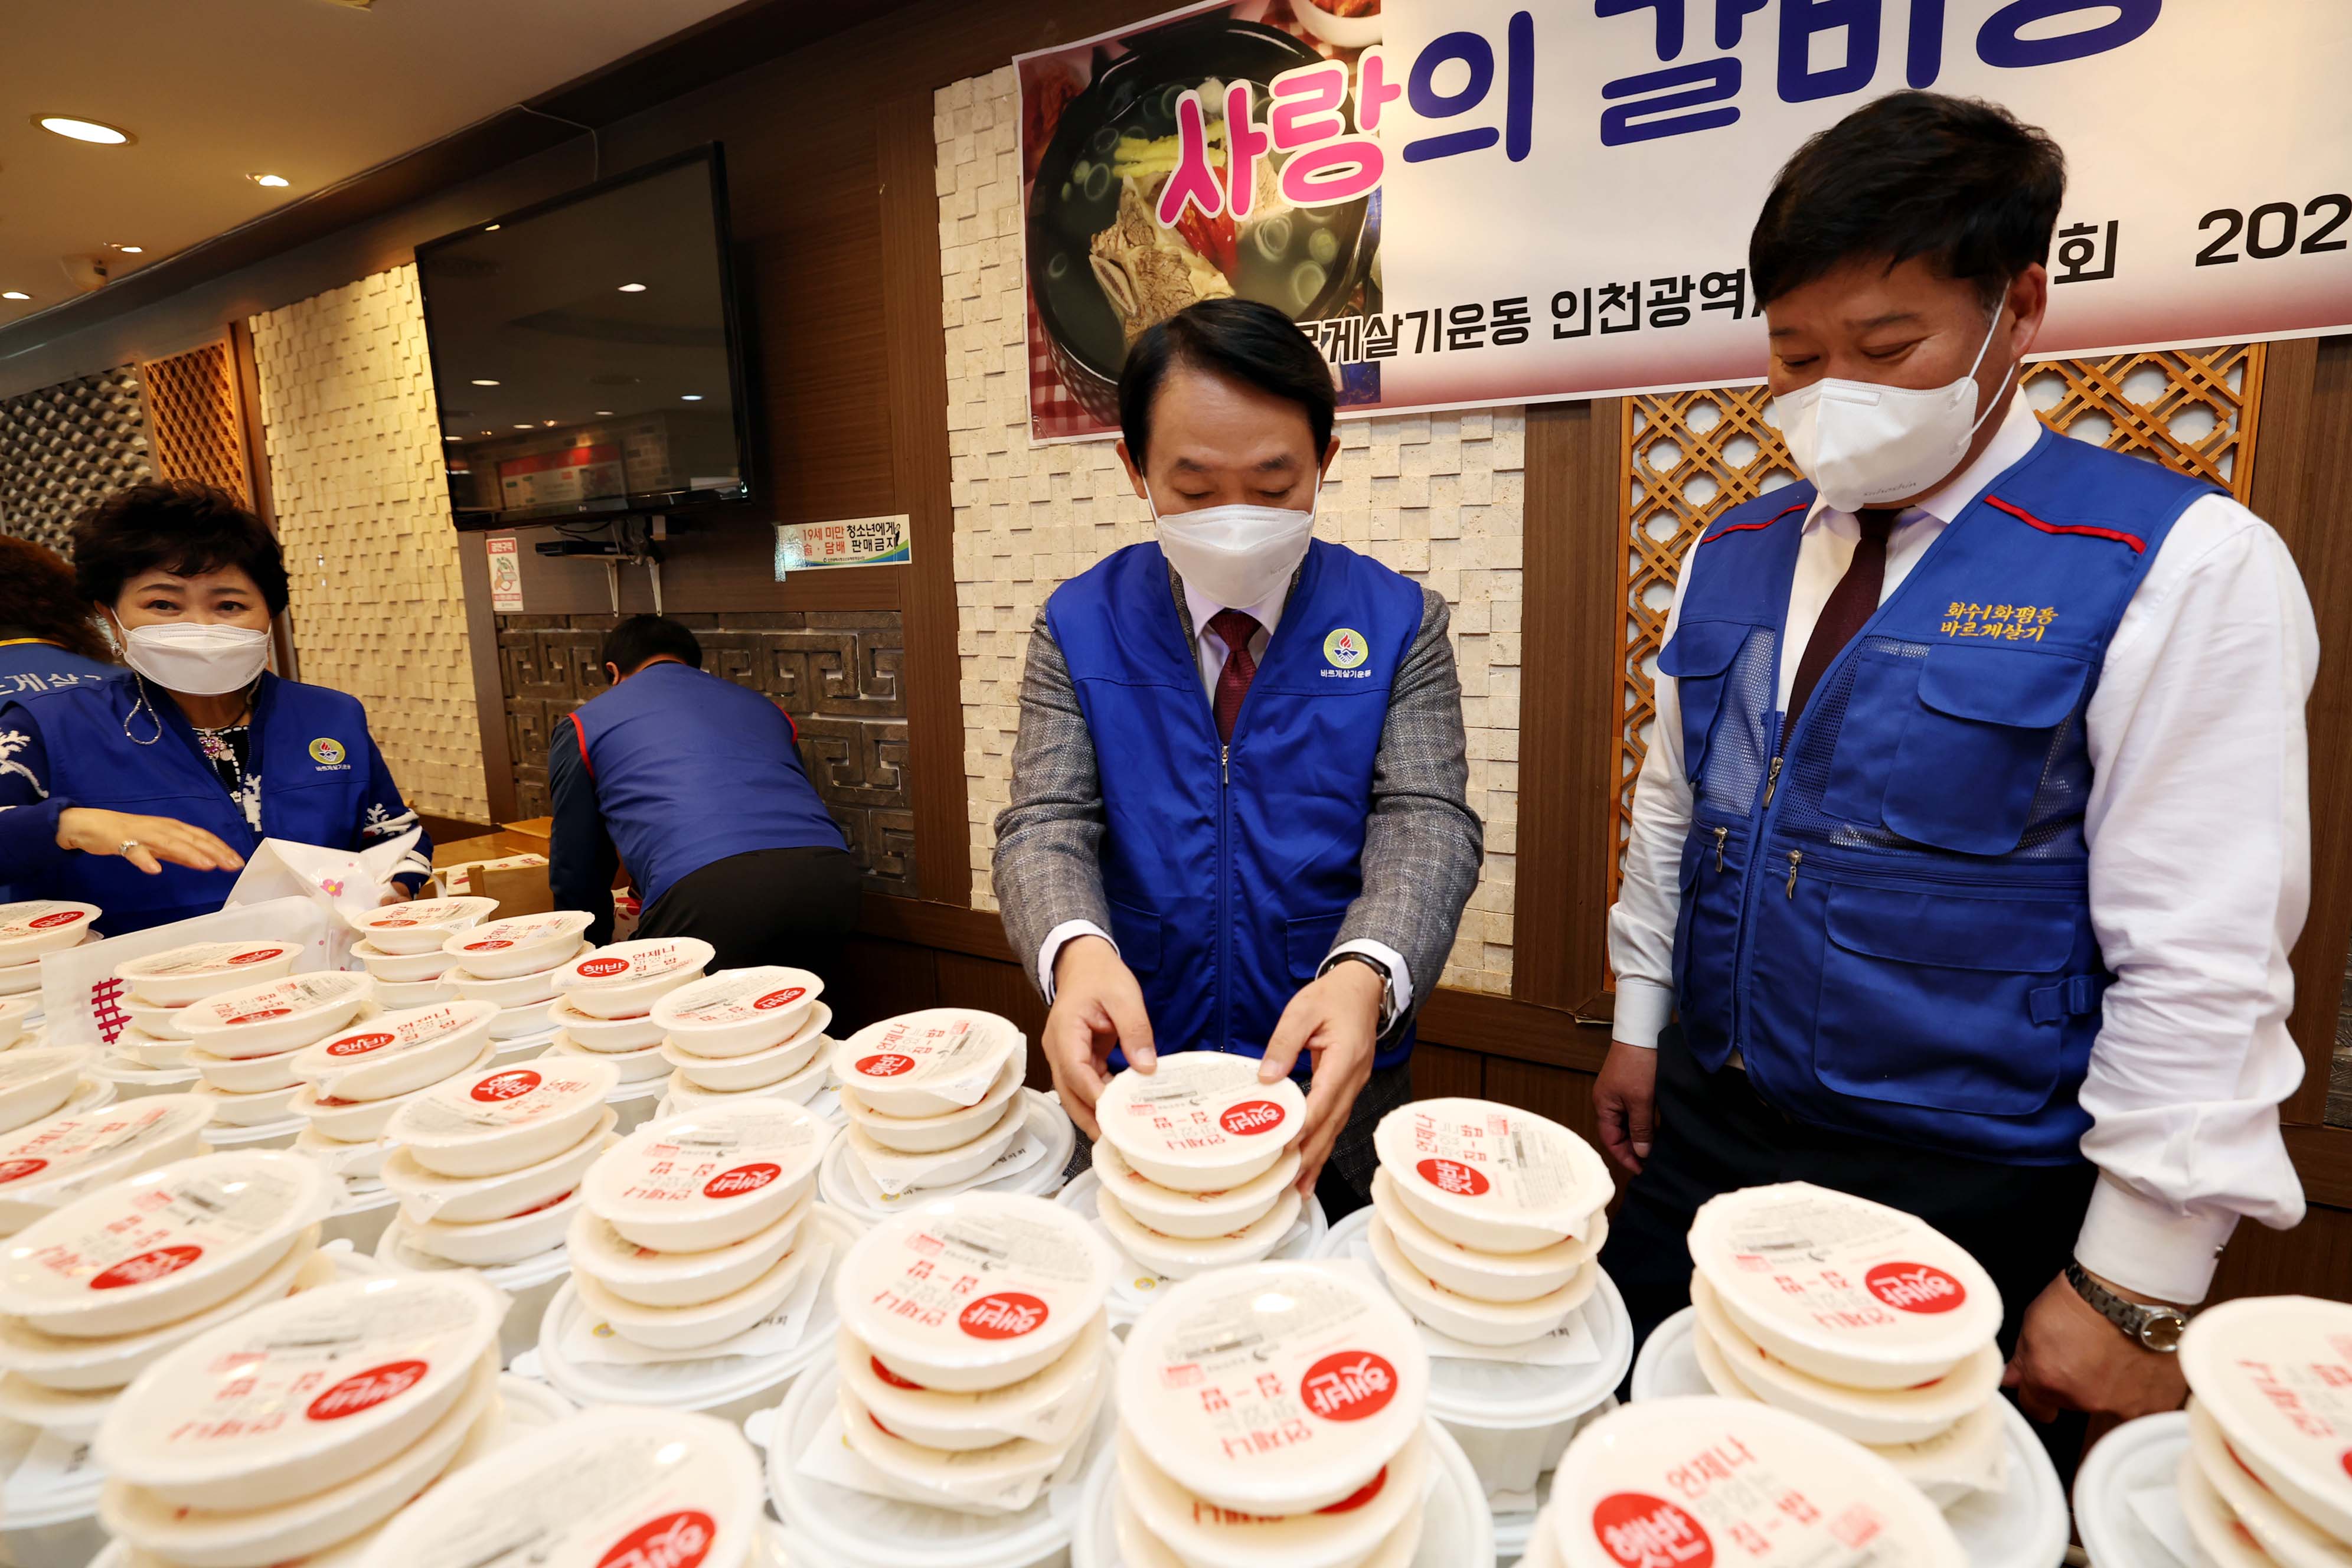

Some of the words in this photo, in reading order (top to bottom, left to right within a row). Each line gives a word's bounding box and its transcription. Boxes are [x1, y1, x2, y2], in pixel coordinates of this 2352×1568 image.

[1158, 11, 1534, 227] 사랑의
[1550, 269, 1764, 339] 인천광역
[803, 527, 822, 541] 19세
[826, 526, 844, 540] 미만
[847, 522, 895, 538] 청소년에게
[825, 541, 845, 554] 담배
[852, 537, 896, 553] 판매금지
[1941, 620, 2045, 642] 바르게살기
[633, 945, 675, 961] 언제나
[583, 961, 626, 975] 햇반
[876, 1023, 910, 1051] 언제나
[865, 1054, 907, 1076] 햇반
[1225, 1103, 1279, 1132] 햇반
[1167, 1133, 1226, 1150] 언제나
[710, 1168, 776, 1191] 햇반
[1435, 1159, 1475, 1194] 햇반
[1872, 1267, 1955, 1308] 햇반
[967, 1297, 1043, 1334] 햇반
[1307, 1355, 1390, 1414] 햇반
[1220, 1417, 1314, 1460] 언제나
